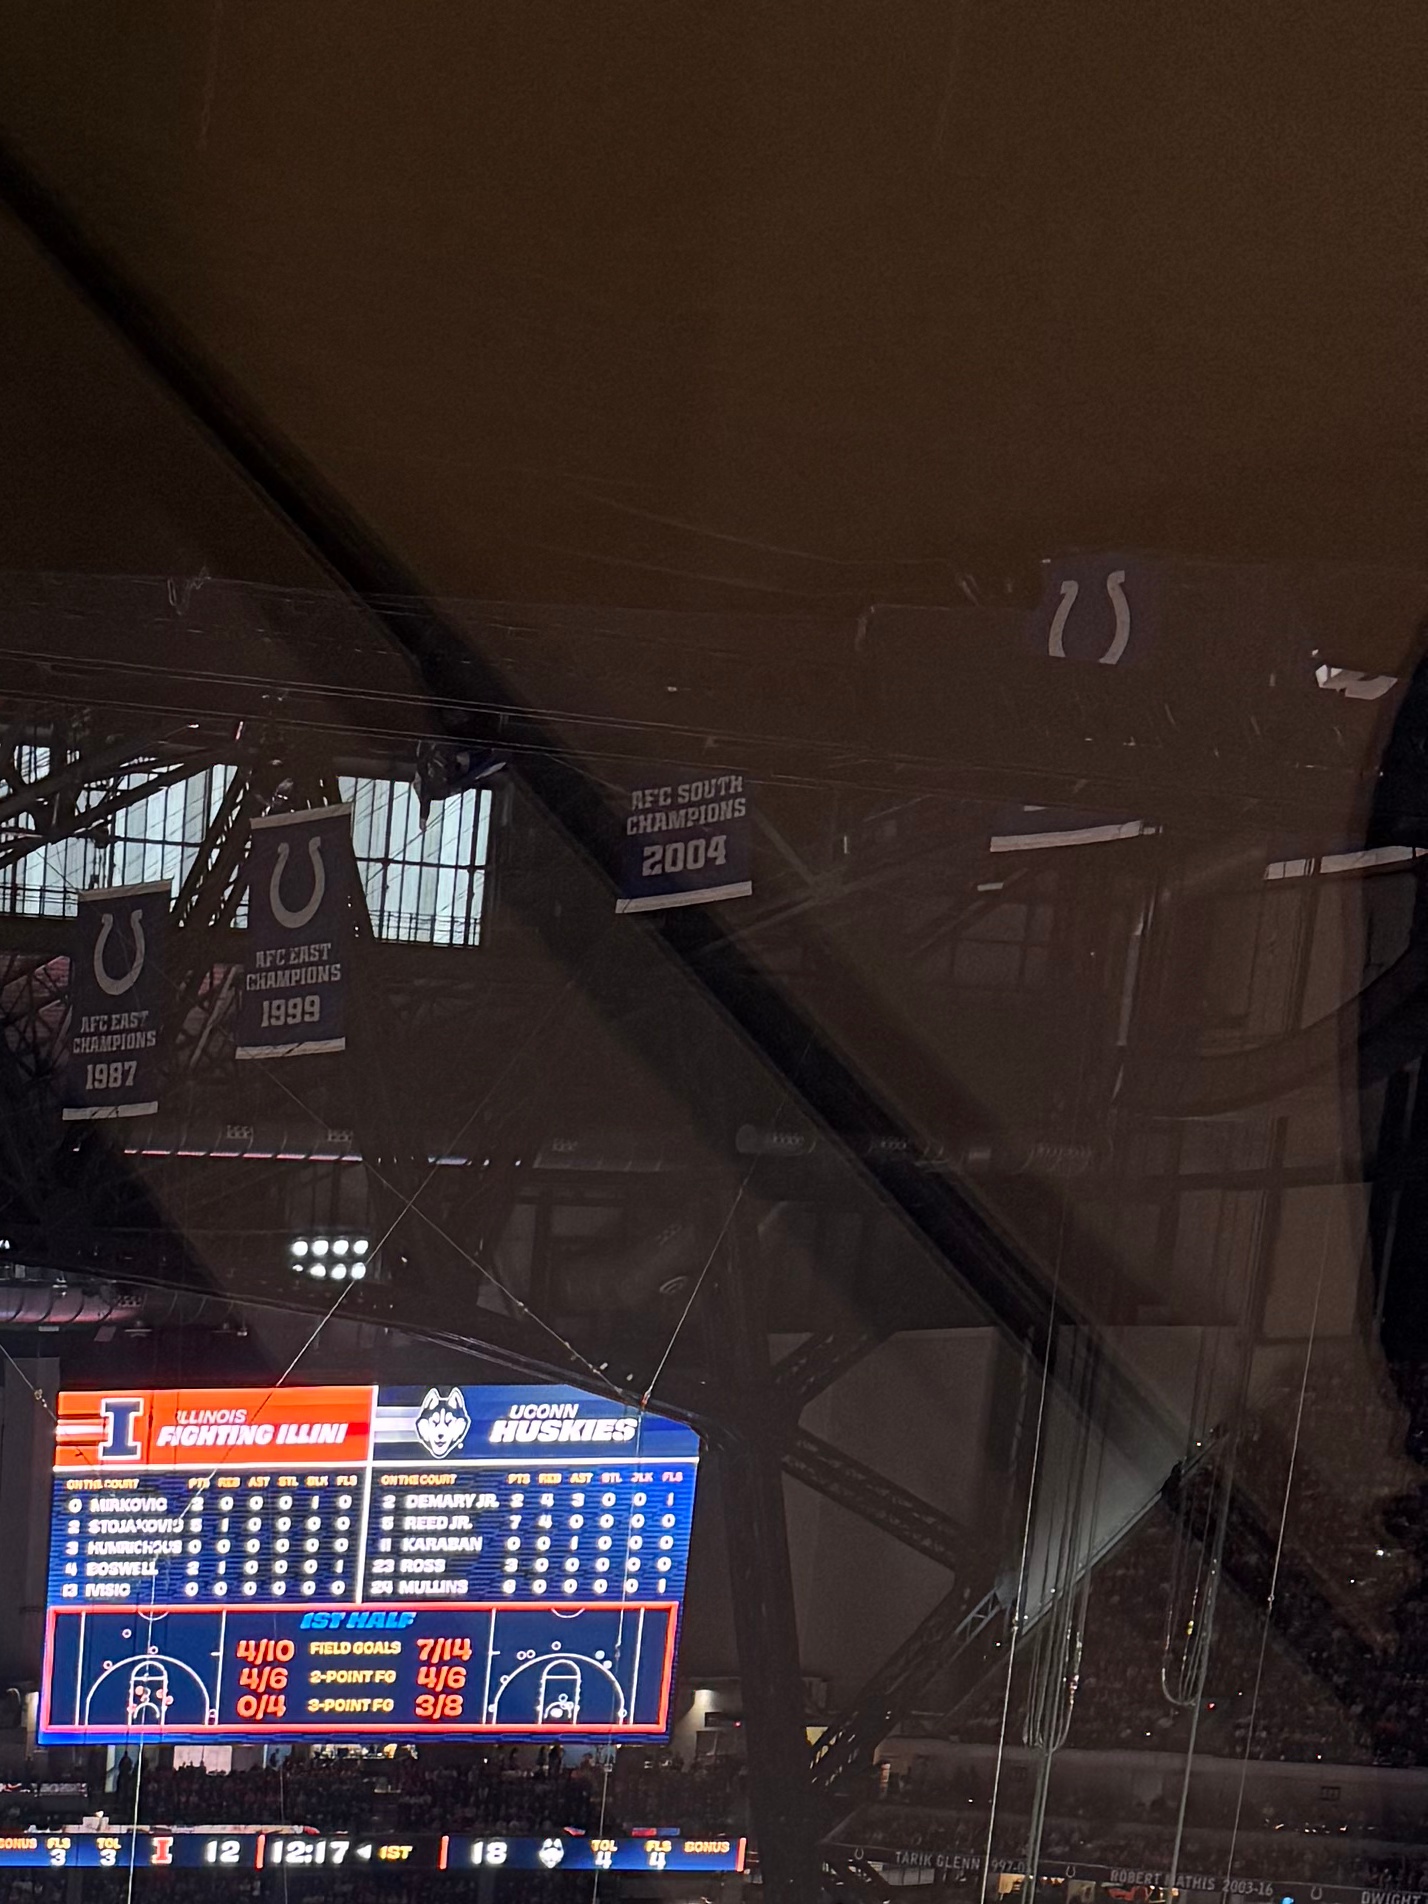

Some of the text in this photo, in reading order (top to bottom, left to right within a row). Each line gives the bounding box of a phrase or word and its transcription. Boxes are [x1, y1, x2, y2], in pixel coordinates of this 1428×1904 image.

[631, 775, 743, 811] AFC SOUTH
[626, 798, 746, 836] CHAMPIONS
[642, 835, 727, 877] 2004
[255, 943, 332, 969] AFC EAST
[246, 963, 342, 991] CHAMPIONS
[80, 1010, 150, 1033] AFC EAST
[260, 994, 321, 1028] 1999
[73, 1030, 157, 1054] CHAMPIONS
[85, 1060, 138, 1090] 1987
[177, 1408, 248, 1424] ILLINOIS
[509, 1403, 579, 1420] UCONN
[156, 1422, 349, 1447] FIGHTING ILLINI
[488, 1418, 639, 1443] HUSKIES
[68, 1497, 168, 1514] 0 MIRKOVIC
[382, 1493, 500, 1509] 2 DEMARY JR.
[67, 1519, 80, 1534] 2
[404, 1515, 473, 1530] REED JR.
[402, 1536, 483, 1552] KARABAN
[65, 1561, 159, 1577] 4 BOSWELL
[372, 1558, 446, 1574] 23 ROSS
[370, 1580, 469, 1595] 24 MULLINS
[299, 1611, 417, 1630] 1ST HALF
[236, 1637, 473, 1666] 4/10 FIELD GOALS 7/14
[238, 1665, 467, 1694] 4/6 2-POINT FG 4/6
[236, 1694, 464, 1721] 0/4 3-POINT FG 3/8
[50, 1850, 667, 1870] 3 3 4 4
[205, 1841, 241, 1863] 12
[271, 1840, 350, 1864] 12:17
[378, 1845, 413, 1860] 1ST
[471, 1842, 508, 1864] 18
[683, 1840, 731, 1854] BONUS
[895, 1851, 933, 1866] TARIK
[936, 1853, 981, 1871] GLENN
[1110, 1869, 1274, 1896] ROBERT 2003-16
